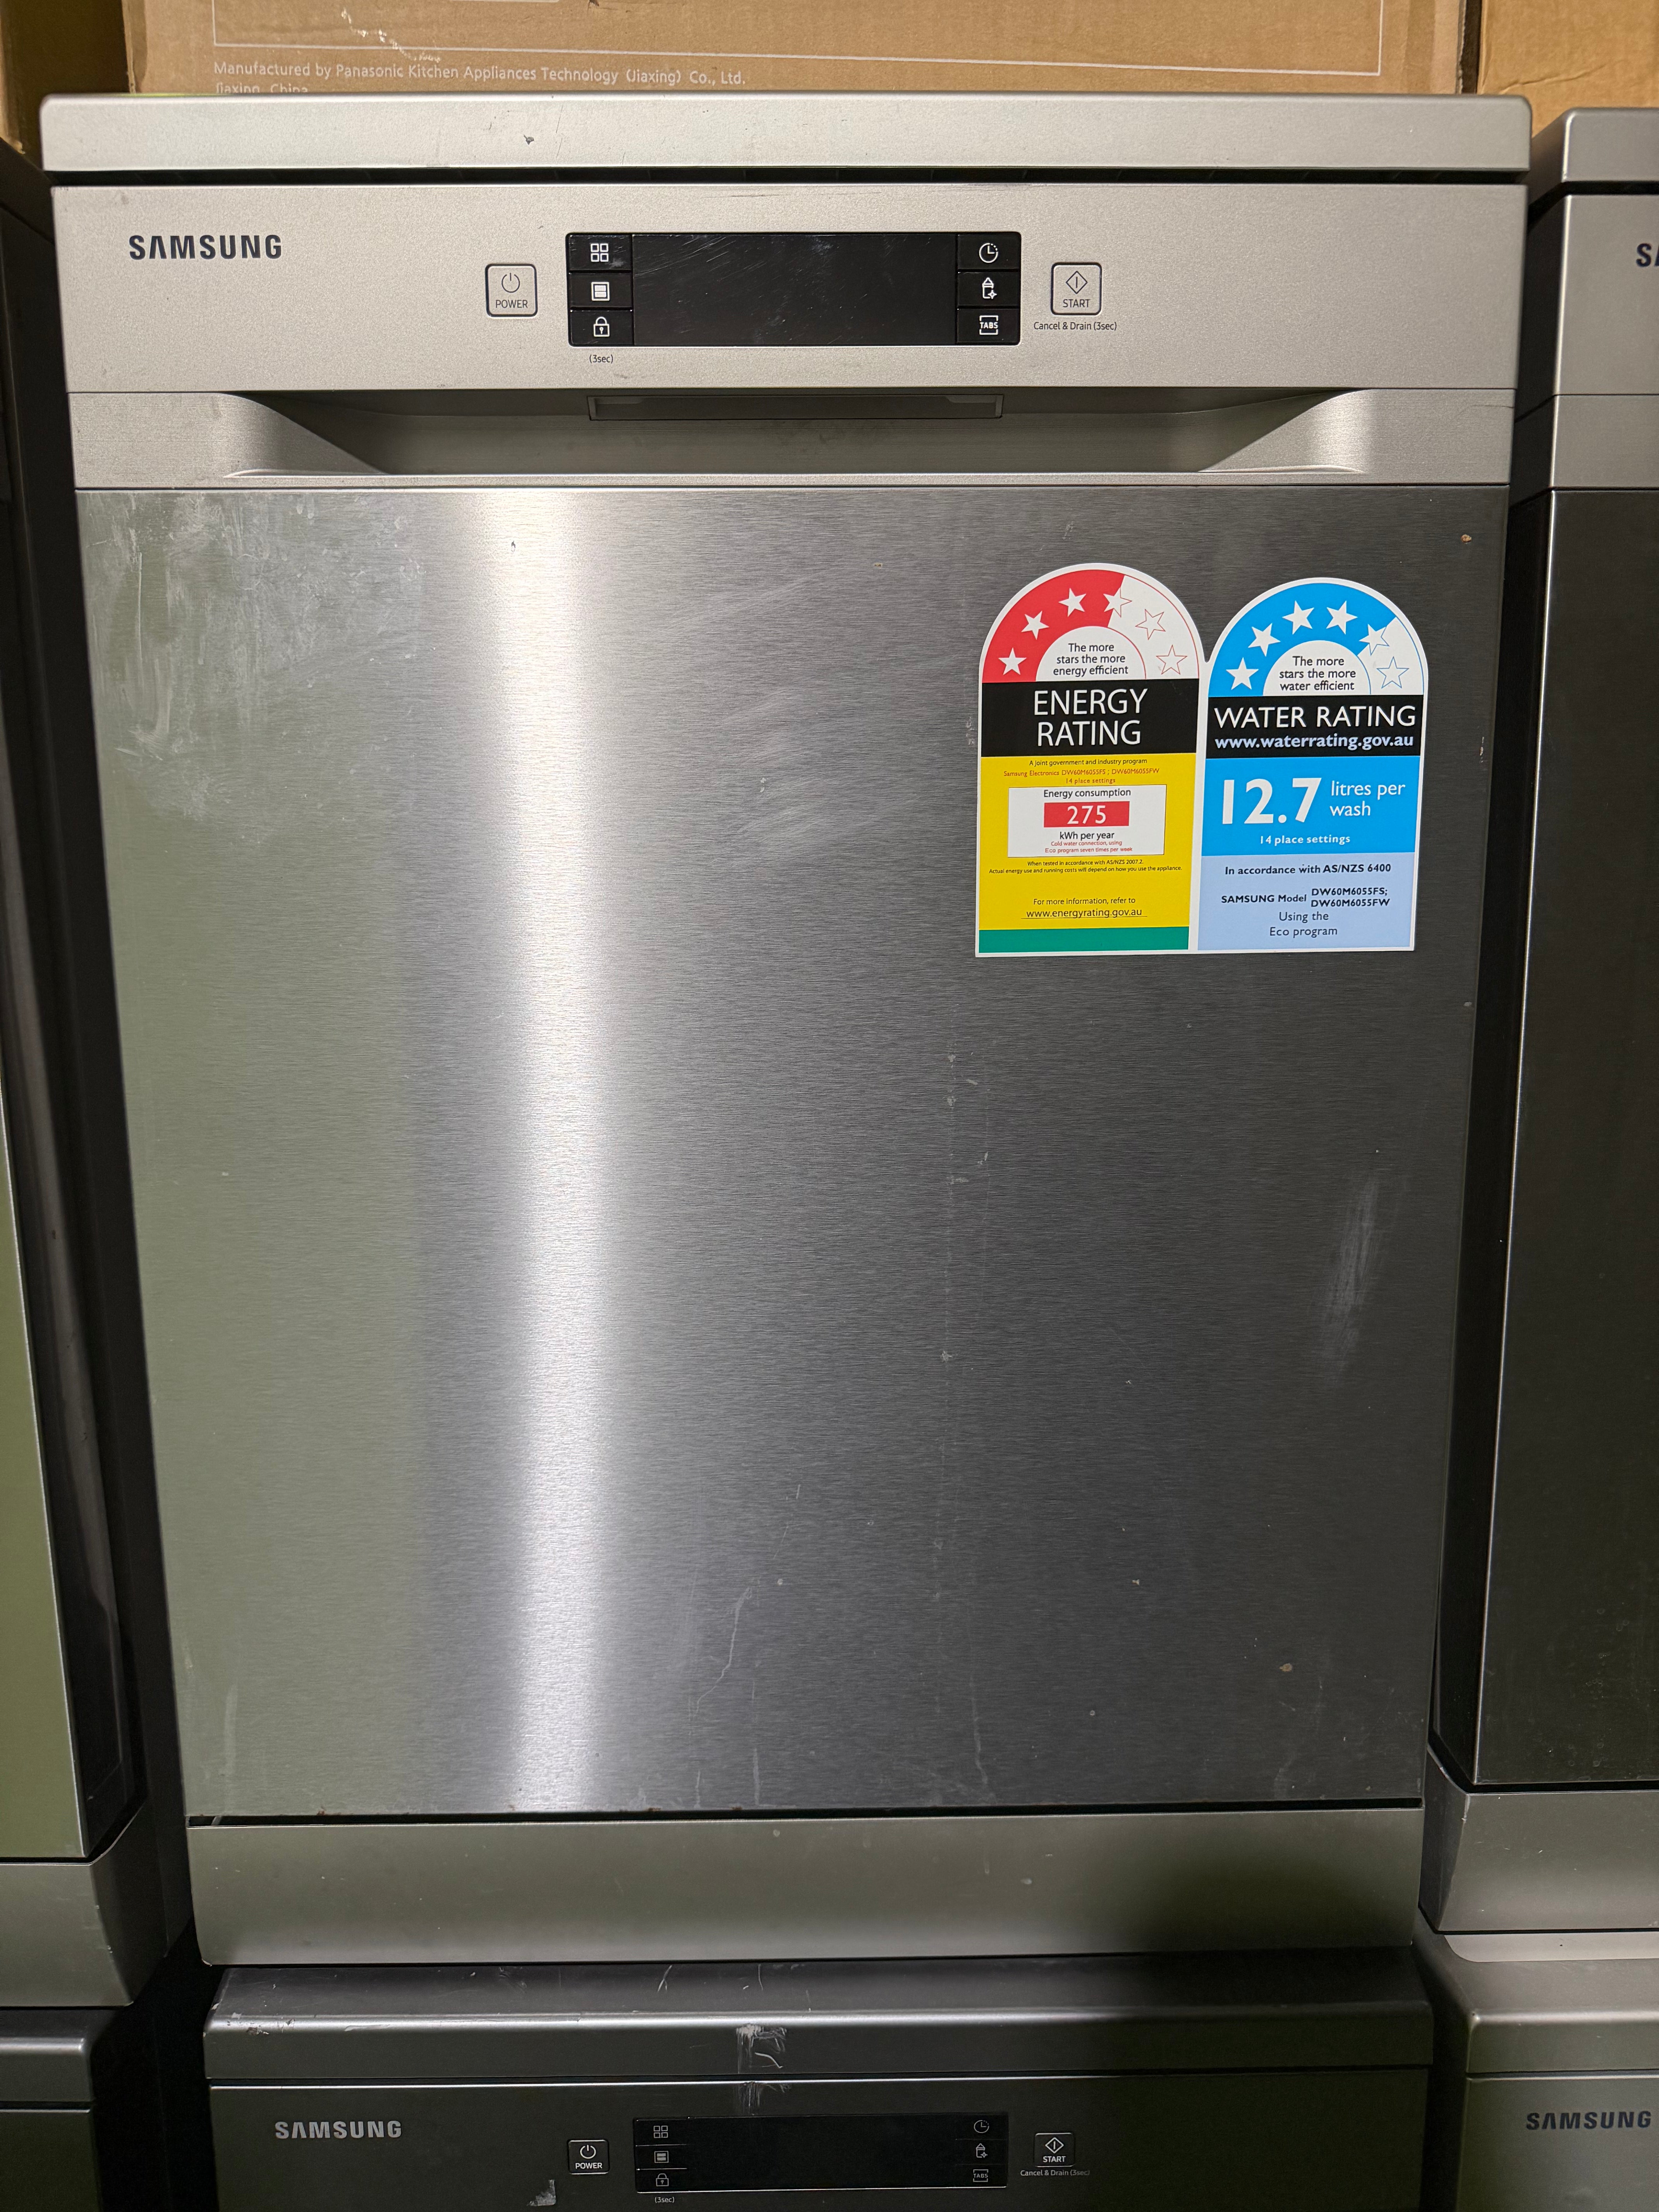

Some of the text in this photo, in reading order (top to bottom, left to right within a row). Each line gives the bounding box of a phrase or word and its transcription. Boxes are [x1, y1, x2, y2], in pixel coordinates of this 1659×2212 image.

[214, 62, 745, 86] Manufactured by Panasonic Kitchen Appliances Technology (Jiaxing) Co., Ltd.
[129, 235, 282, 260] SAMSUNG
[1636, 243, 1659, 267] S
[496, 300, 528, 308] POWER
[1063, 299, 1090, 308] START
[1034, 321, 1117, 331] Cancel & Drain (3sec)
[589, 355, 613, 363] (3sec)
[1068, 643, 1086, 652] The
[1057, 655, 1080, 664] stars
[1081, 654, 1098, 663] the
[1292, 656, 1344, 666] The more
[1053, 666, 1128, 677] energy efficient
[1279, 670, 1304, 679] stars
[1308, 669, 1324, 678] the
[1280, 681, 1355, 691] water efficient
[1034, 689, 1148, 715] ENERGY
[1214, 706, 1415, 728] WATER RATING
[1038, 720, 1140, 746] RATING
[1214, 733, 1413, 750] www.waterrating.gov.au
[1044, 789, 1131, 799] Energy consumption
[1331, 781, 1405, 800] litres per
[1222, 778, 1322, 824] 12.7
[1330, 801, 1370, 816] wash
[1067, 805, 1106, 824] 275
[1060, 831, 1078, 840] kWh
[1096, 832, 1115, 840] year
[1260, 835, 1351, 846] 14 place settings
[1238, 866, 1295, 874] accordance
[1298, 864, 1321, 873] with
[1323, 865, 1364, 873] AS/NZS
[1367, 864, 1391, 872] 6400
[1312, 888, 1388, 896] DW60M6055FS;
[1221, 894, 1307, 903] SAMSUNG Model
[1311, 898, 1390, 907] DW60M6055FW
[1026, 908, 1142, 918] www.energyrating.gov.au
[1279, 911, 1329, 923] Using the
[1270, 927, 1338, 938] Eco program
[1526, 2111, 1652, 2130] SAMSUNG
[275, 2121, 402, 2139] SAMSUNG
